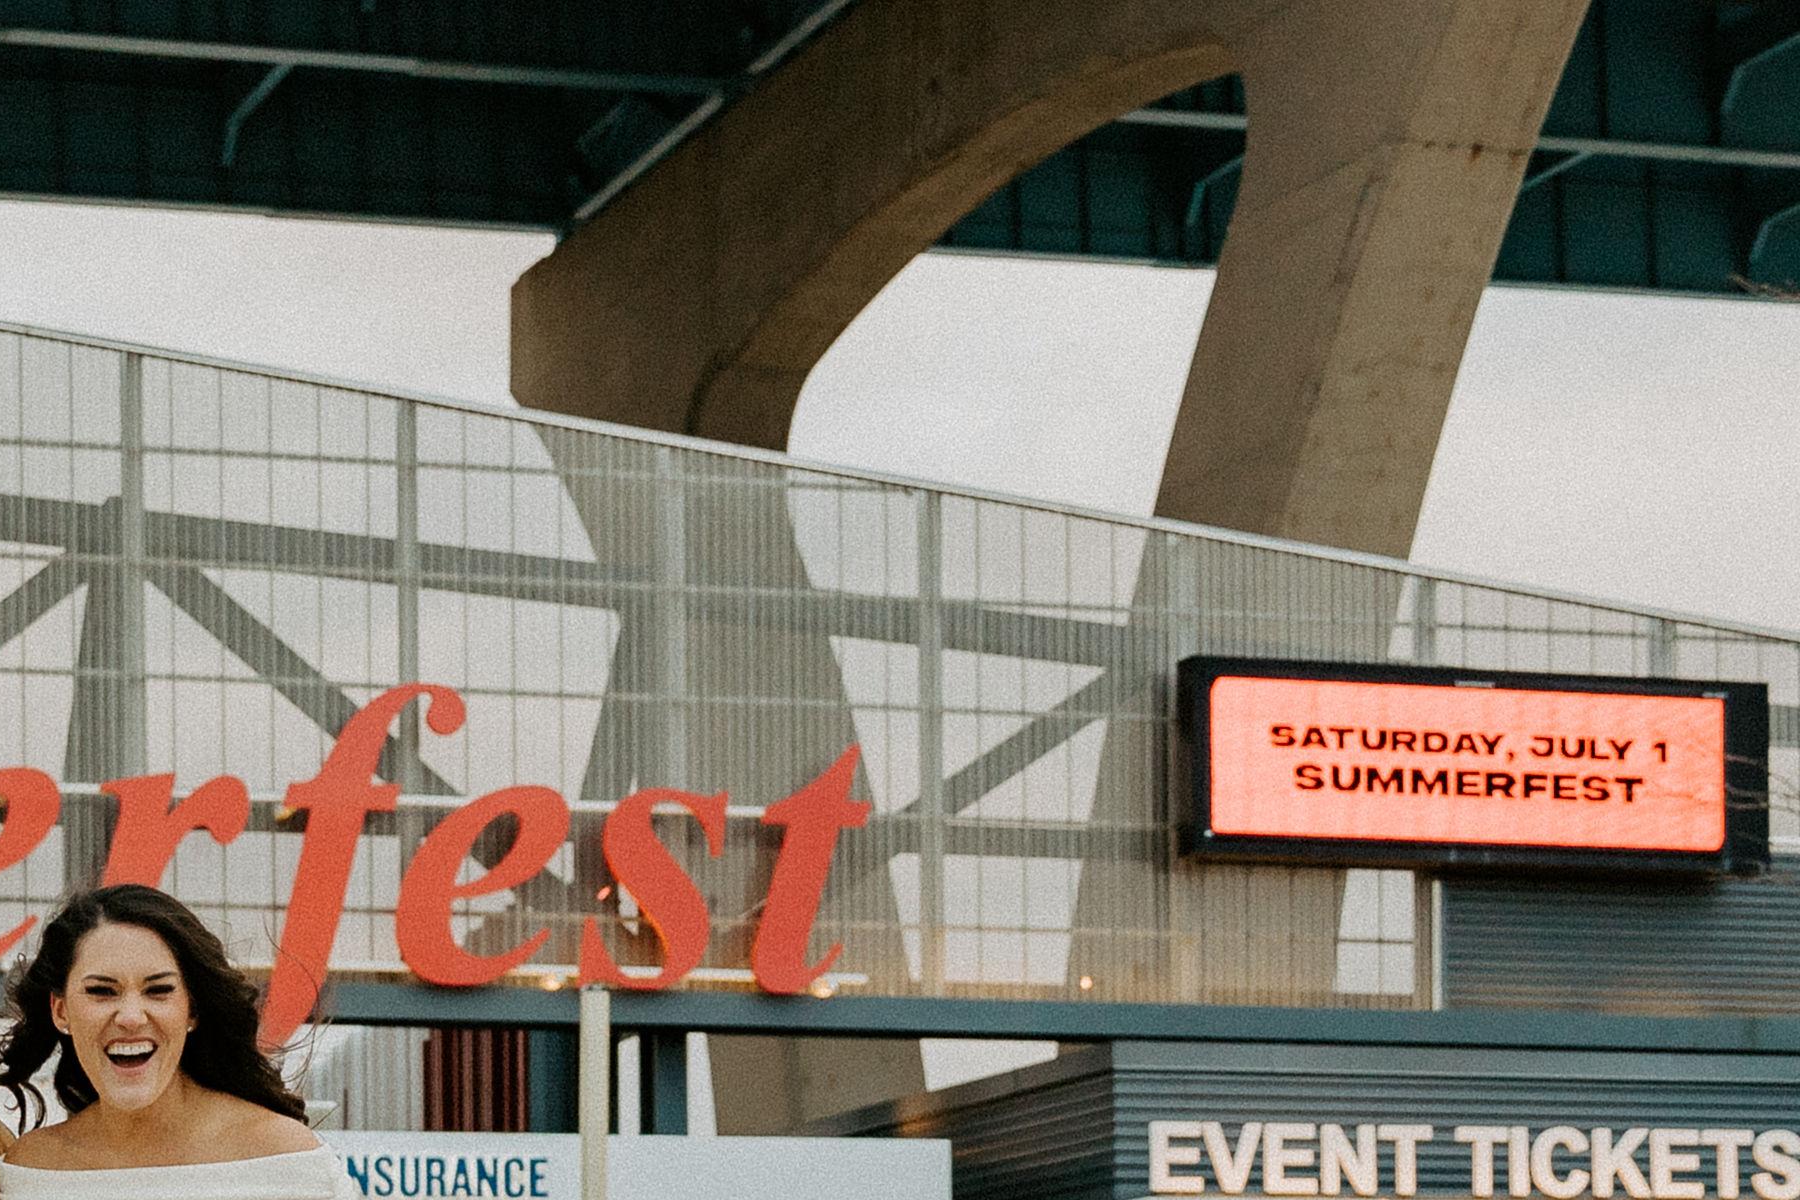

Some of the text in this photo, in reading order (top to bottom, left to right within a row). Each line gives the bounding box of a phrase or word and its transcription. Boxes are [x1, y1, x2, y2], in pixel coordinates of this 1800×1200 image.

[1270, 725, 1668, 763] SATURDAY, JULY 1
[1294, 764, 1644, 804] SUMMERFEST
[337, 1155, 549, 1198] NSURANCE
[1147, 1119, 1434, 1197] EVENT
